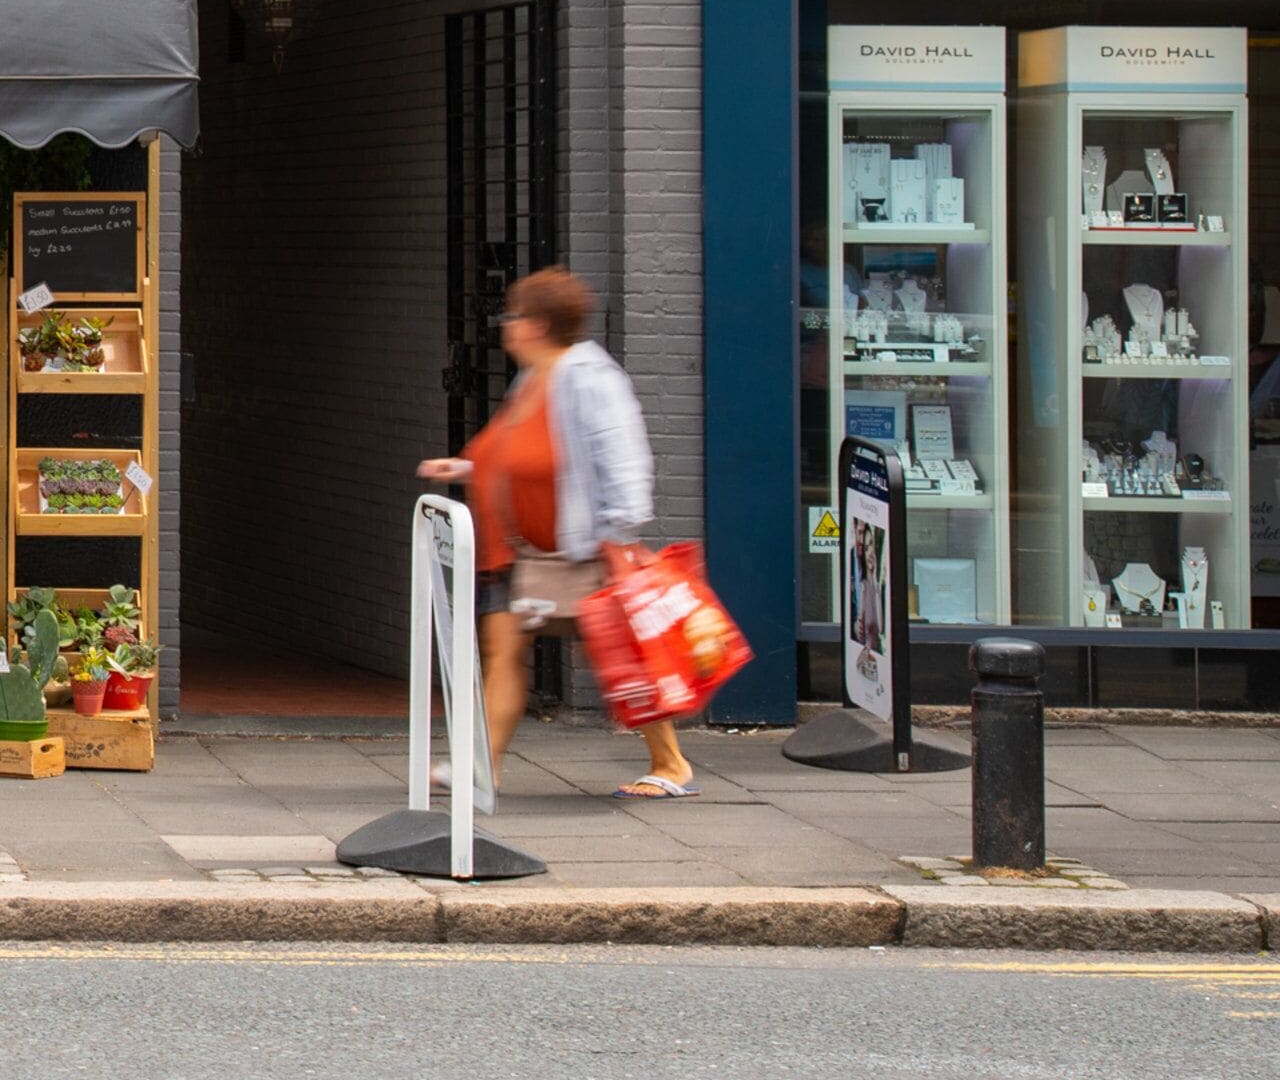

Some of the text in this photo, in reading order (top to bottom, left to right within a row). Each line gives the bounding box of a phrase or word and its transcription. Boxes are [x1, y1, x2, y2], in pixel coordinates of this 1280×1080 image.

[860, 44, 973, 58] DAVID HALL
[1100, 45, 1216, 59] DAVID HALL
